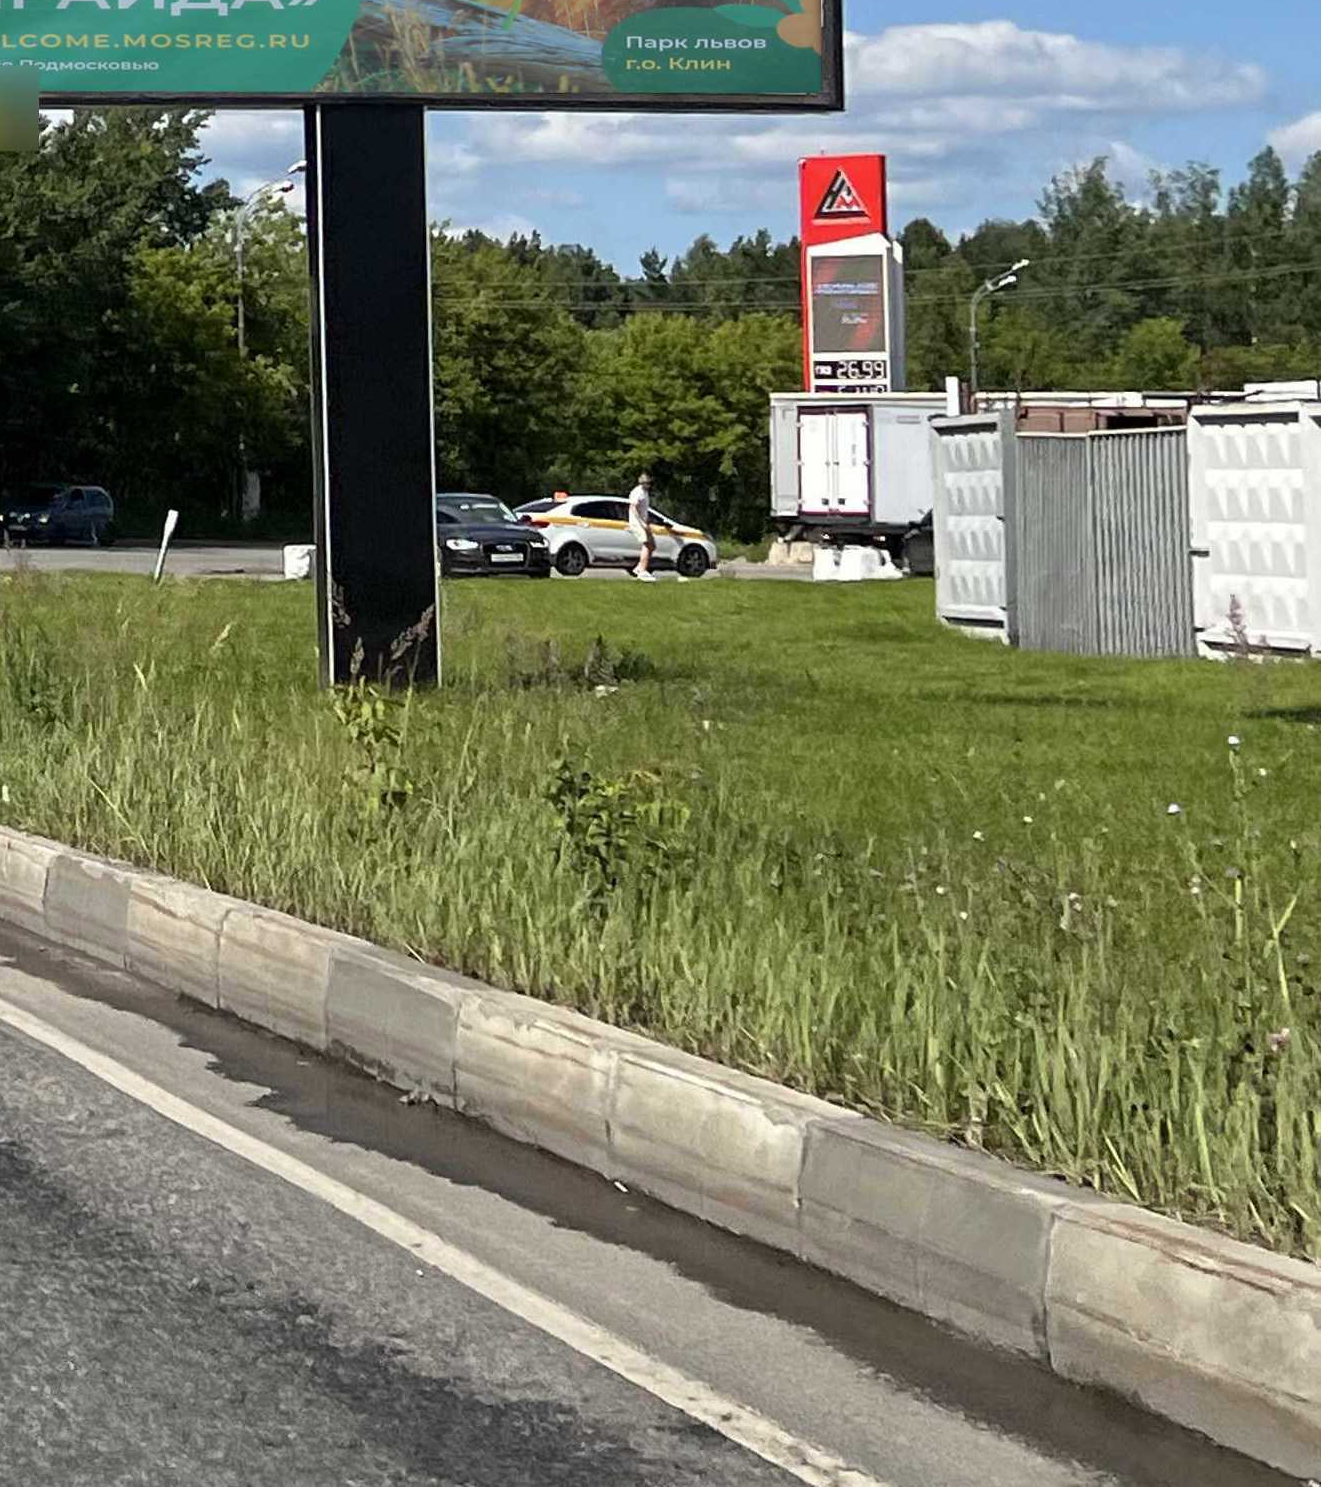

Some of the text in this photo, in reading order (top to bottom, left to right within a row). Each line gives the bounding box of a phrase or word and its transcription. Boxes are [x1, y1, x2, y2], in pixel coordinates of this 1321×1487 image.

[626, 35, 767, 52] Парк львов
[626, 57, 732, 71] г.о. Клин
